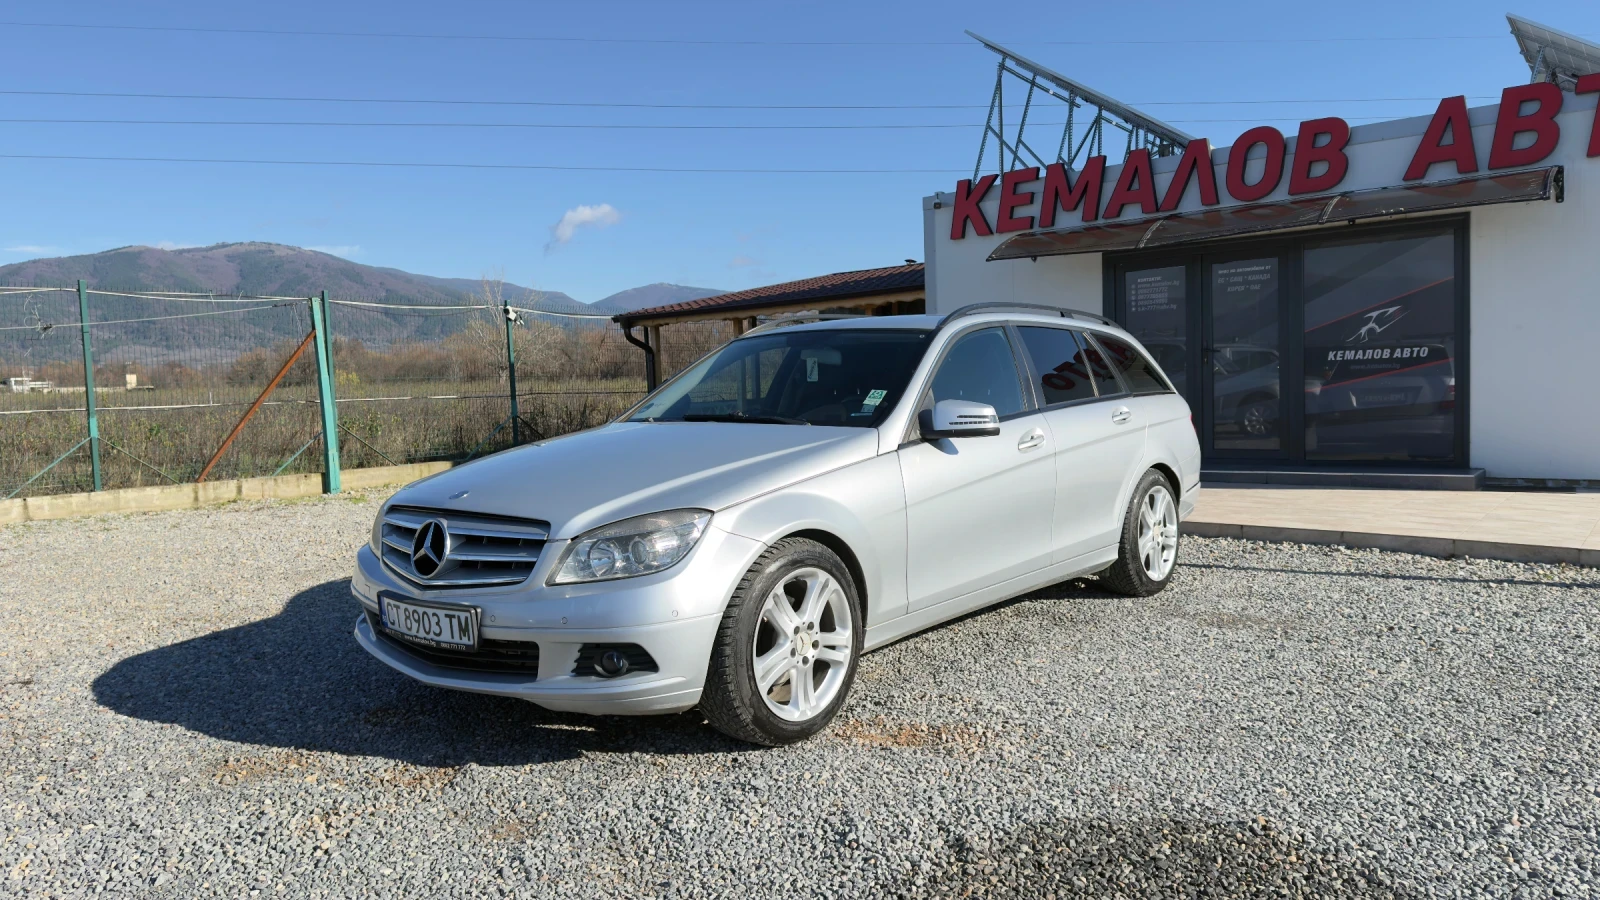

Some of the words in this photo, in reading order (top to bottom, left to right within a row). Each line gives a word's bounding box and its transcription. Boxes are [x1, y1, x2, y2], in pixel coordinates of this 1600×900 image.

[950, 117, 1350, 240] КЕМАЛОВ
[1248, 273, 1271, 281] КАНАДА
[1327, 348, 1391, 361] КЕМАЛОВ
[1392, 346, 1429, 359] АВТО
[403, 607, 442, 637] 8903
[444, 613, 471, 642] TM
